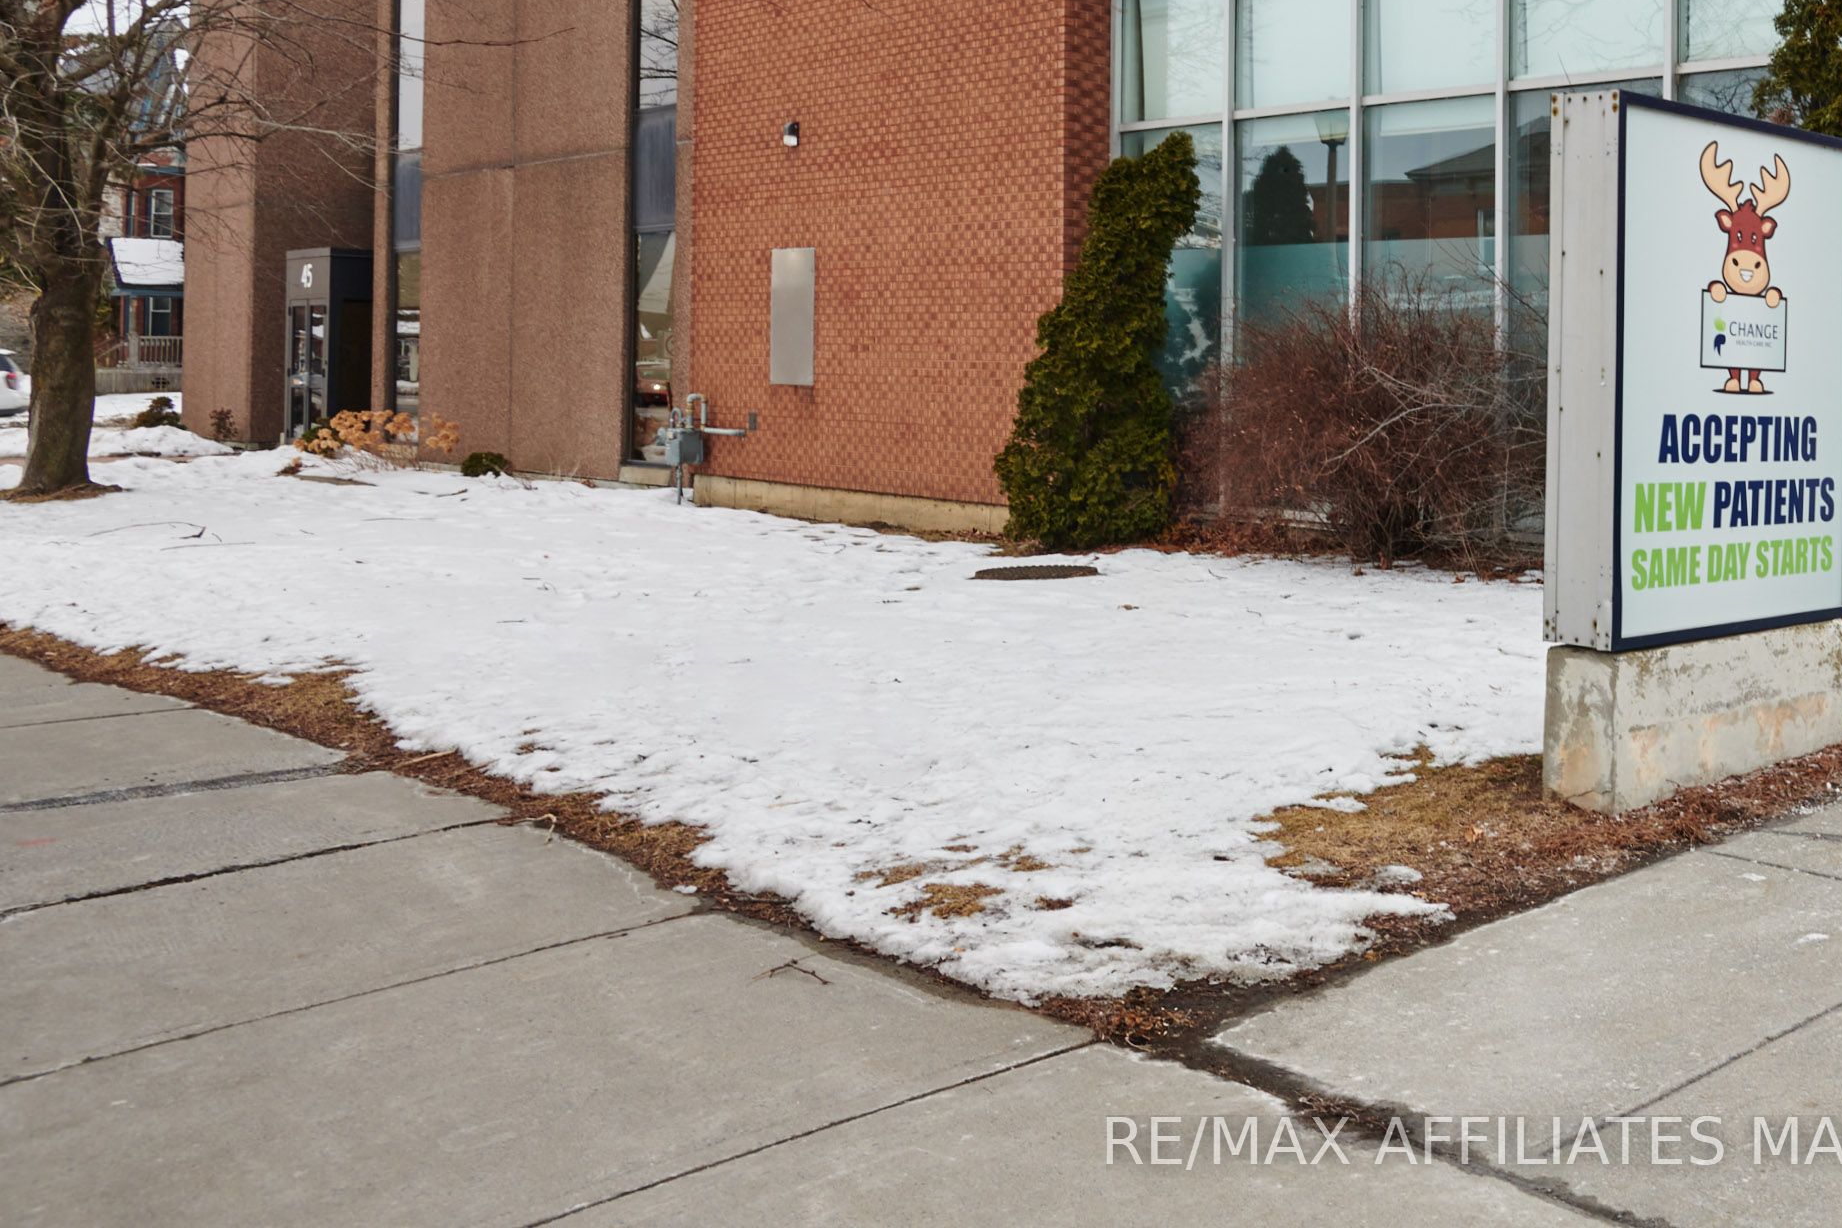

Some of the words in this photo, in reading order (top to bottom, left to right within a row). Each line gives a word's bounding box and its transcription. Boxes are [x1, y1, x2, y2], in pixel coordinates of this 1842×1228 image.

[1729, 321, 1779, 340] CHANGE
[1658, 413, 1818, 464] ACCEPTING
[1634, 481, 1707, 533] NEW
[1713, 477, 1835, 529] PATIENTS
[1631, 546, 1702, 591] SAME
[1707, 542, 1751, 583] DAY
[1755, 535, 1833, 578] STARTS
